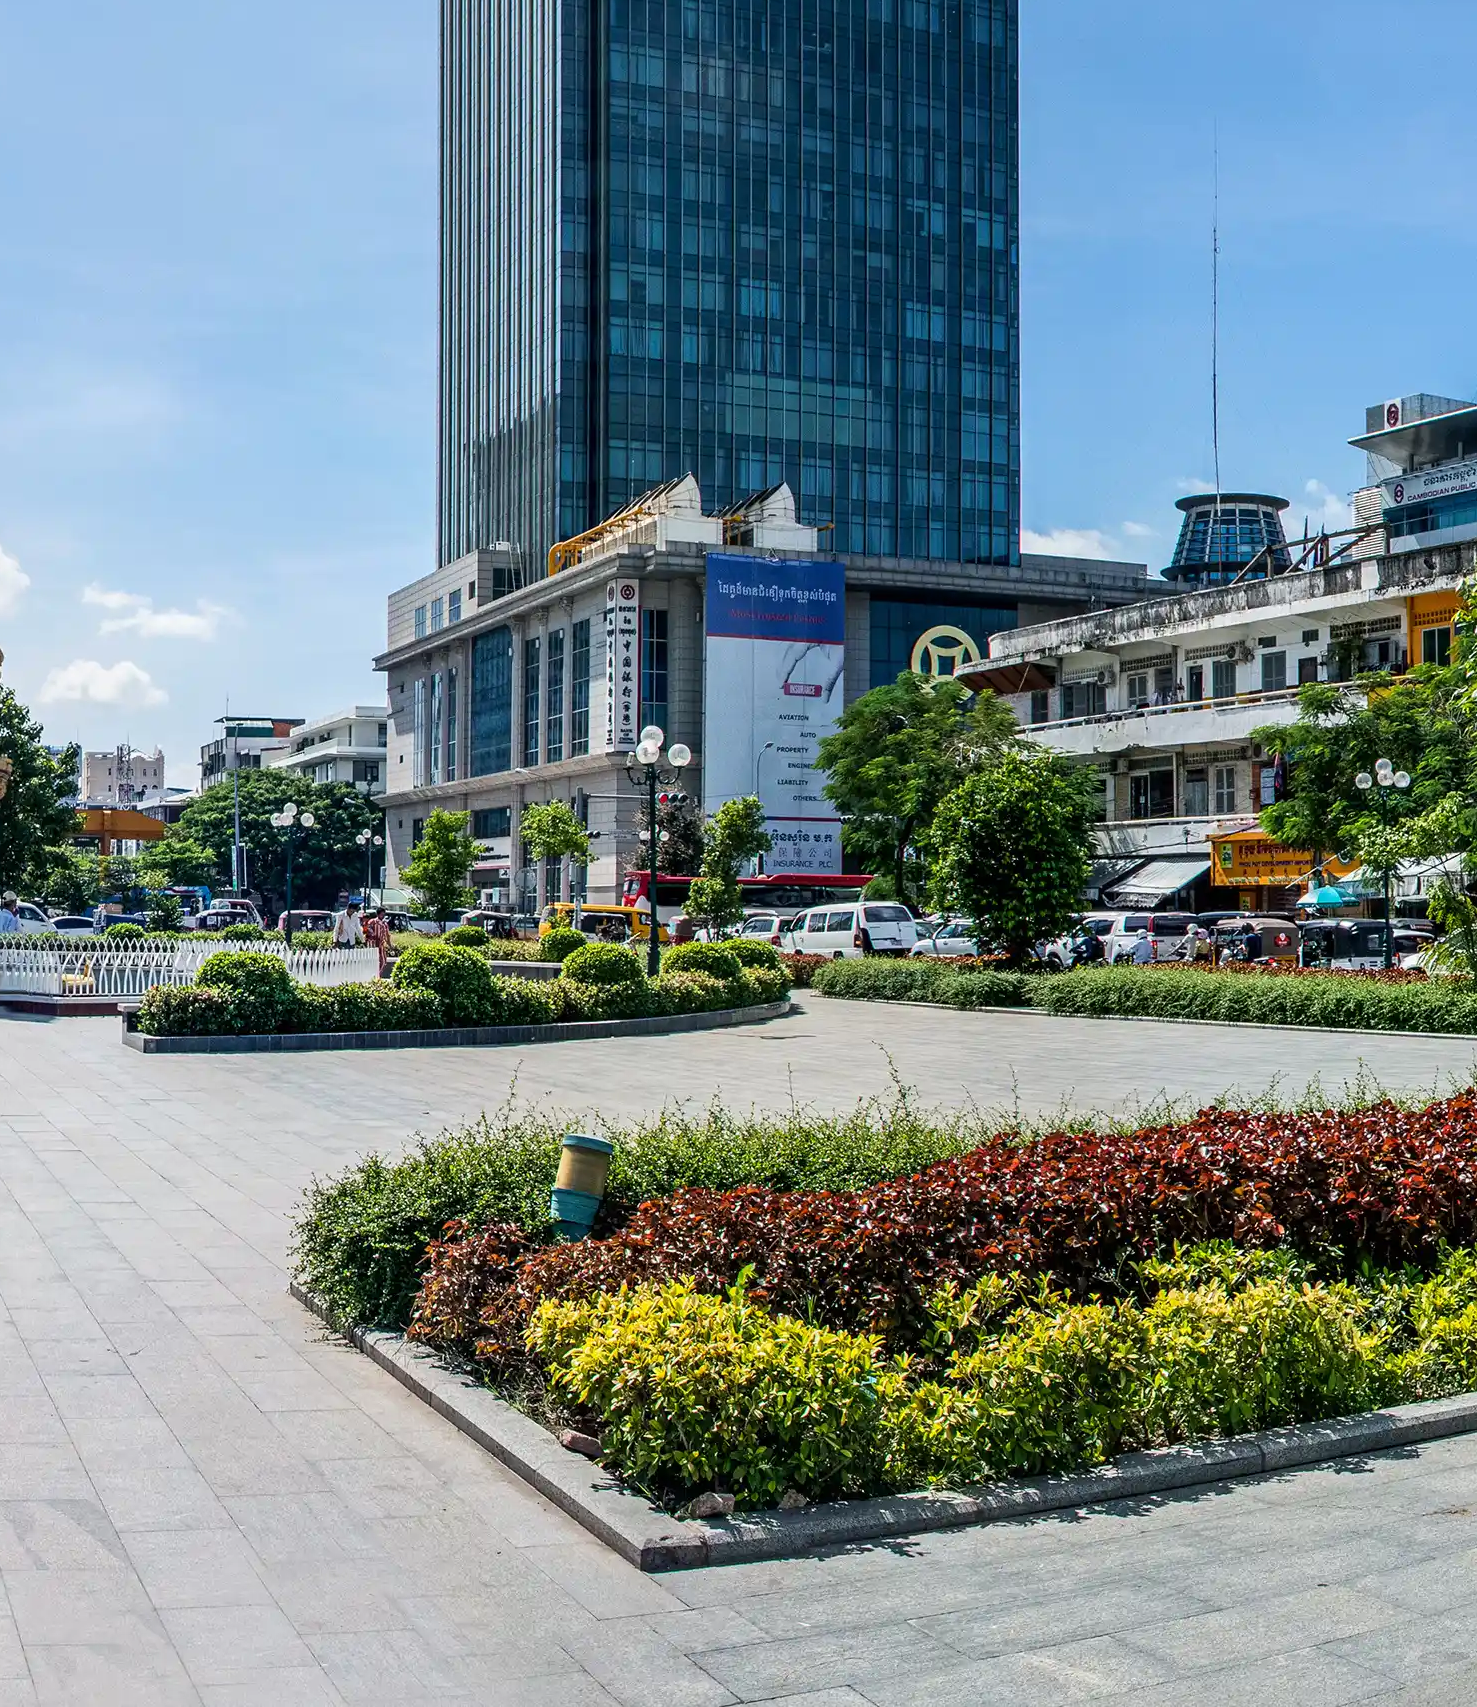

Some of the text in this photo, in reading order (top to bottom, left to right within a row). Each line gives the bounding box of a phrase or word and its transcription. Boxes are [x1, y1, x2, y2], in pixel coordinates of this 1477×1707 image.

[1407, 487, 1450, 502] CAMBODIAN
[1450, 481, 1476, 493] PUBLIC
[789, 684, 816, 695] INSURANCE
[778, 714, 809, 722] AVIATION
[776, 746, 809, 754] PROPERTY
[773, 860, 814, 868] INSURANCE
[818, 860, 833, 868] PLC.
